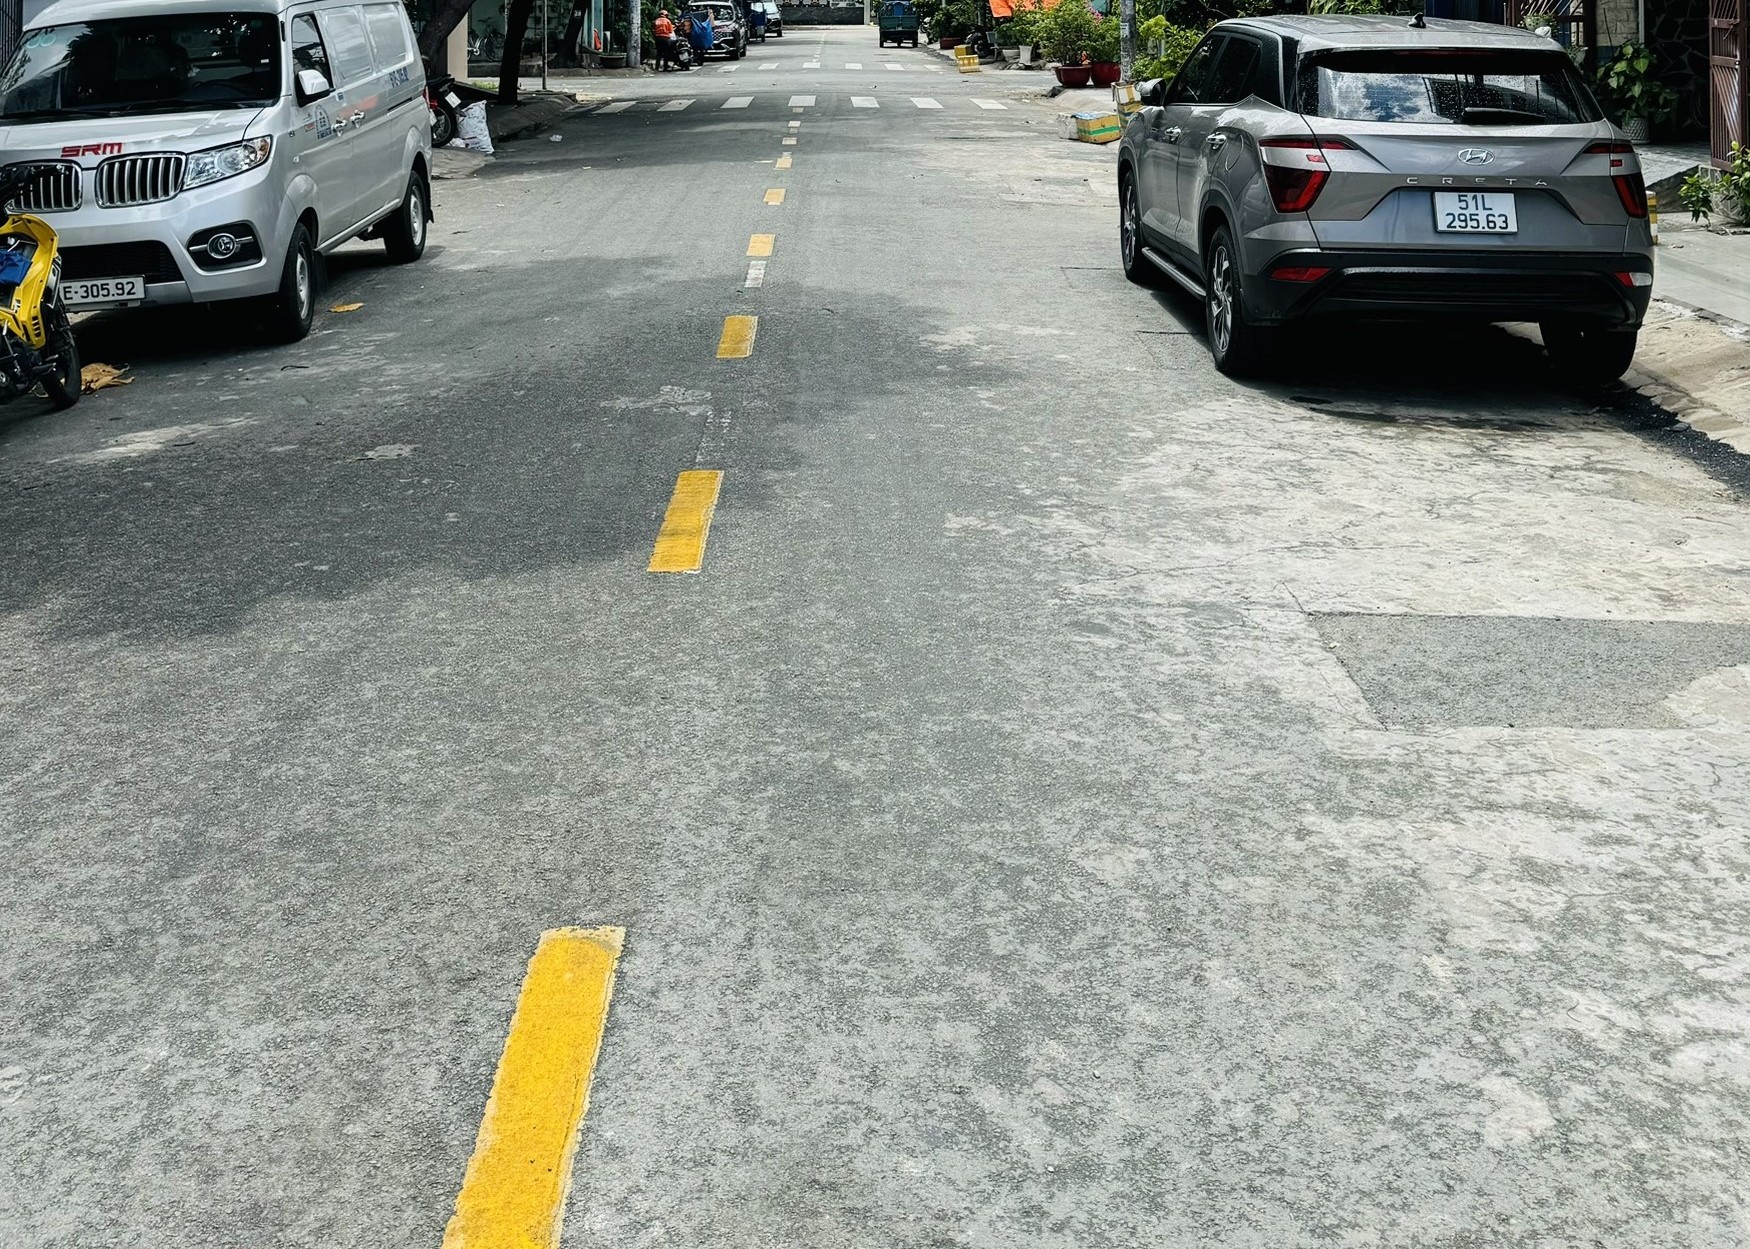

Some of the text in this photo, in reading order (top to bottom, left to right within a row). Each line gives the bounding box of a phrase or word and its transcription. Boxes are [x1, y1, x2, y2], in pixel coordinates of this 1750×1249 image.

[60, 142, 123, 158] SRM
[1406, 176, 1548, 186] CRETA
[1457, 194, 1493, 211] 51L
[1445, 213, 1509, 231] 295.63
[63, 281, 136, 301] E-305.92
